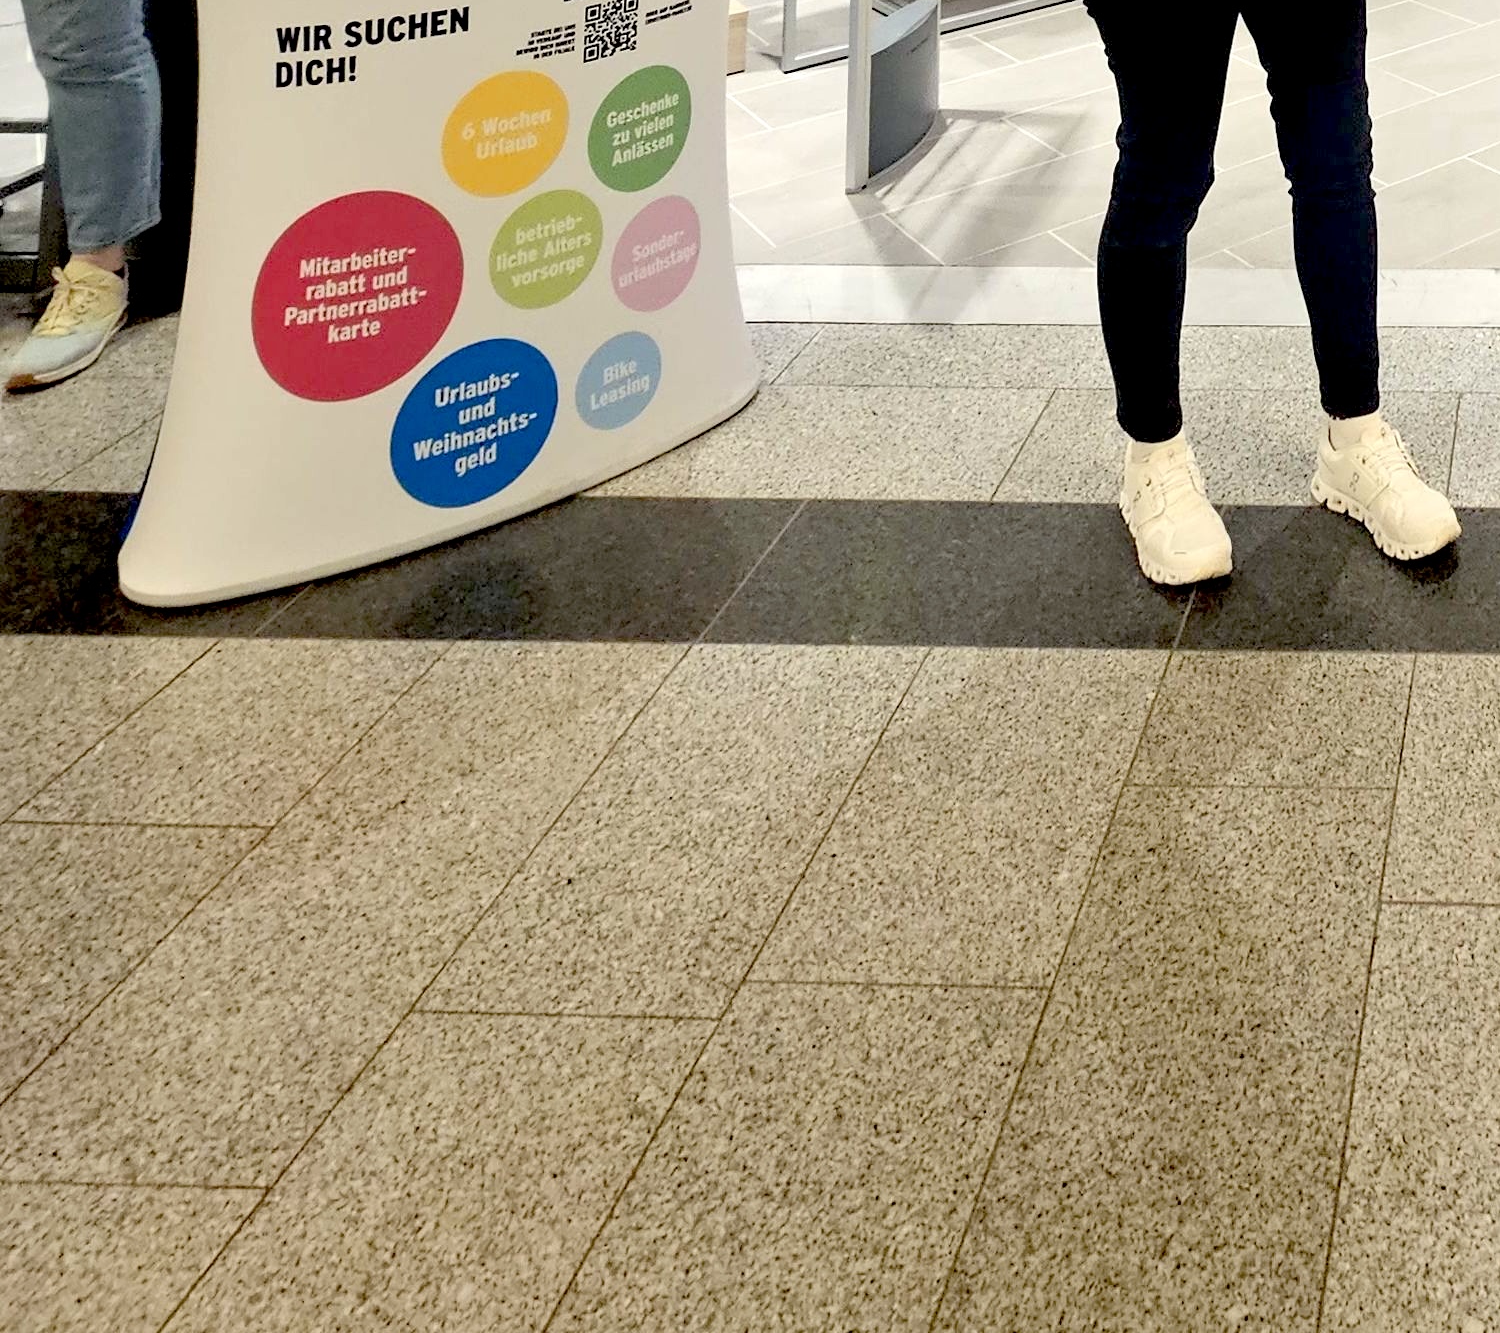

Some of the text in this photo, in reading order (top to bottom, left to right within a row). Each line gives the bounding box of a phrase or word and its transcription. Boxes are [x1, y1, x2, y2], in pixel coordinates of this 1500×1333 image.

[276, 6, 470, 53] WIR SUCHEN
[275, 55, 357, 88] DICH!
[461, 107, 553, 141] 6 Wochen
[606, 92, 680, 129] Geschenke
[475, 131, 538, 161] Urlaub
[612, 113, 674, 147] zu vielen
[611, 132, 674, 167] Anlässen
[515, 214, 583, 246] betrieb-
[631, 229, 684, 263] Sonder-
[298, 246, 417, 279] Mitarbeiter-
[495, 231, 593, 273] liche Alters
[617, 242, 699, 289] urlaubstage
[304, 265, 409, 302] rabatt und
[510, 254, 586, 289] vorsorge
[283, 286, 428, 327] Partnerrabatt-
[327, 318, 382, 344] karte
[603, 358, 638, 386] Bike
[434, 371, 520, 409] Urlaubs-
[590, 373, 651, 411] Leasing
[458, 396, 496, 425] und
[413, 411, 538, 462] Weihnachts-
[454, 443, 498, 478] geld
